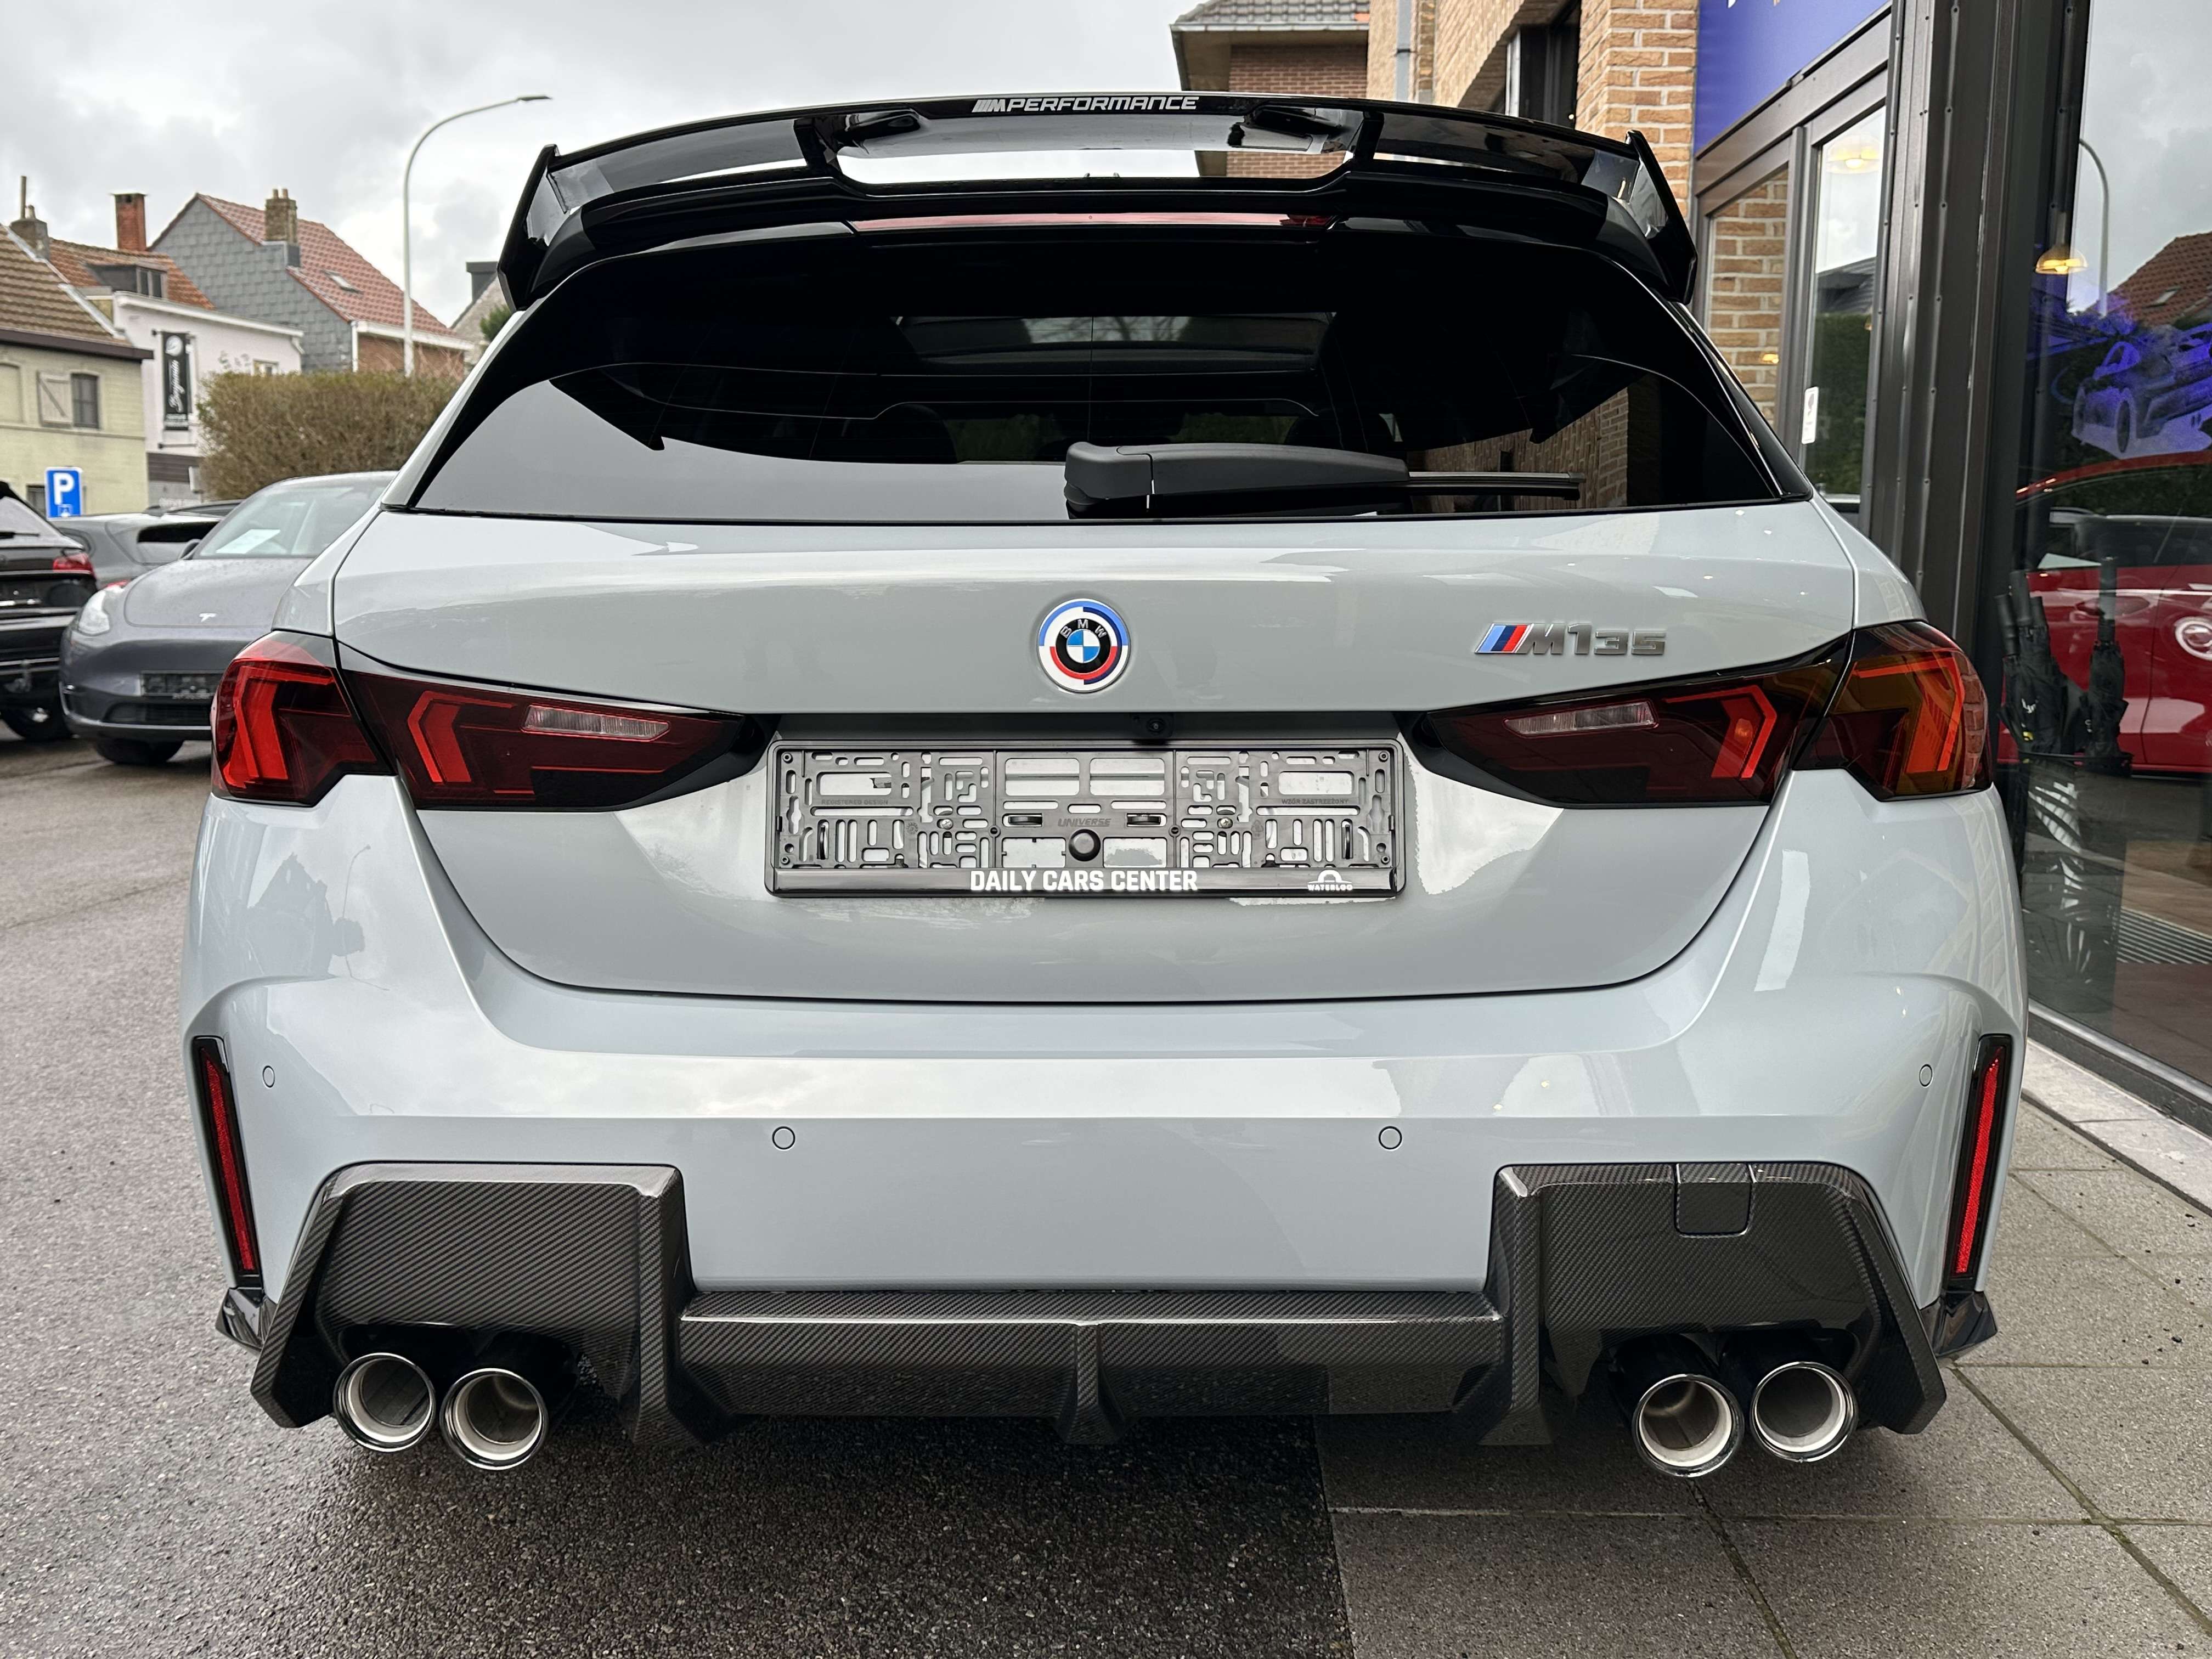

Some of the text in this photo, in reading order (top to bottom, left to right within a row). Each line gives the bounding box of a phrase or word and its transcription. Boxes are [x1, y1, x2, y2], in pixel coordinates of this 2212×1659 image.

[53, 472, 75, 505] P
[1059, 618, 1107, 639] BMW
[1515, 622, 1667, 655] M135
[1057, 817, 1113, 827] UNIVERSE
[970, 870, 1198, 891] DAILY CARS CENTER
